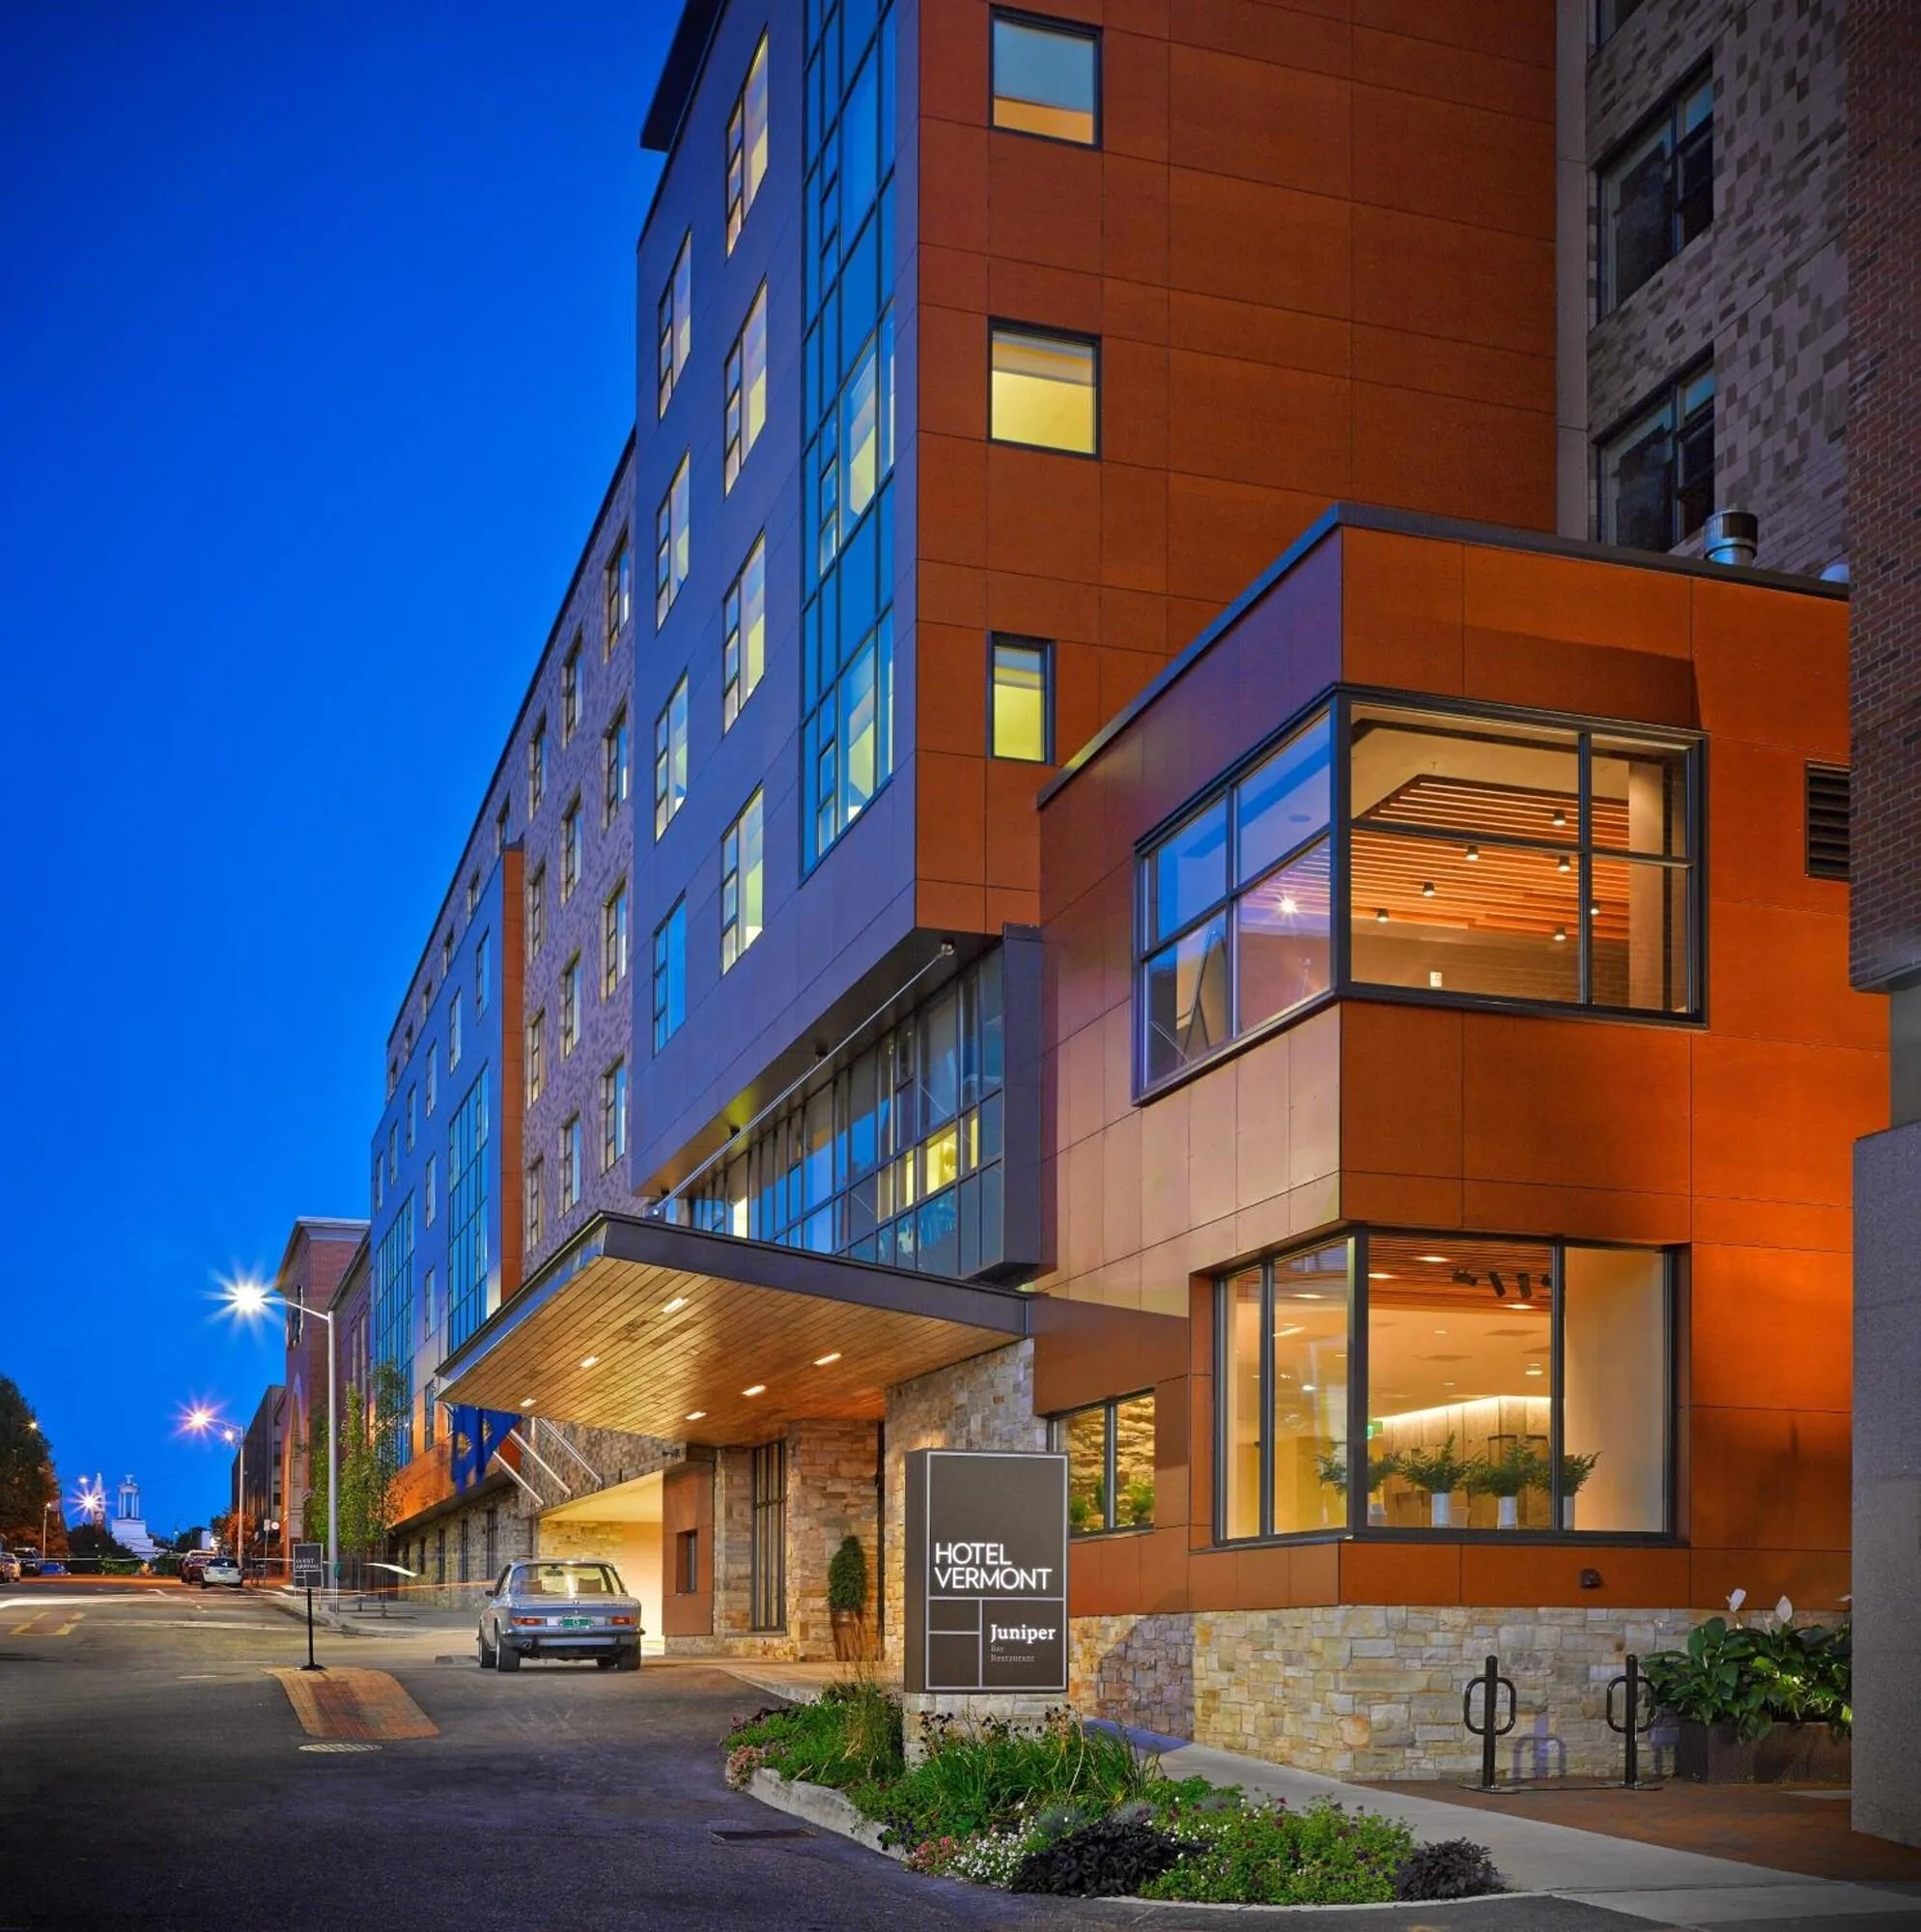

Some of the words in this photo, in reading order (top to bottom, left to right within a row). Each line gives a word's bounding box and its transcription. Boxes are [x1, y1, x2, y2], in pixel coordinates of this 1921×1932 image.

[935, 1543, 1012, 1565] HOTEL
[935, 1567, 1053, 1590] VERMONT
[990, 1624, 1056, 1644] Juniper
[990, 1654, 1034, 1662] Restaurant
